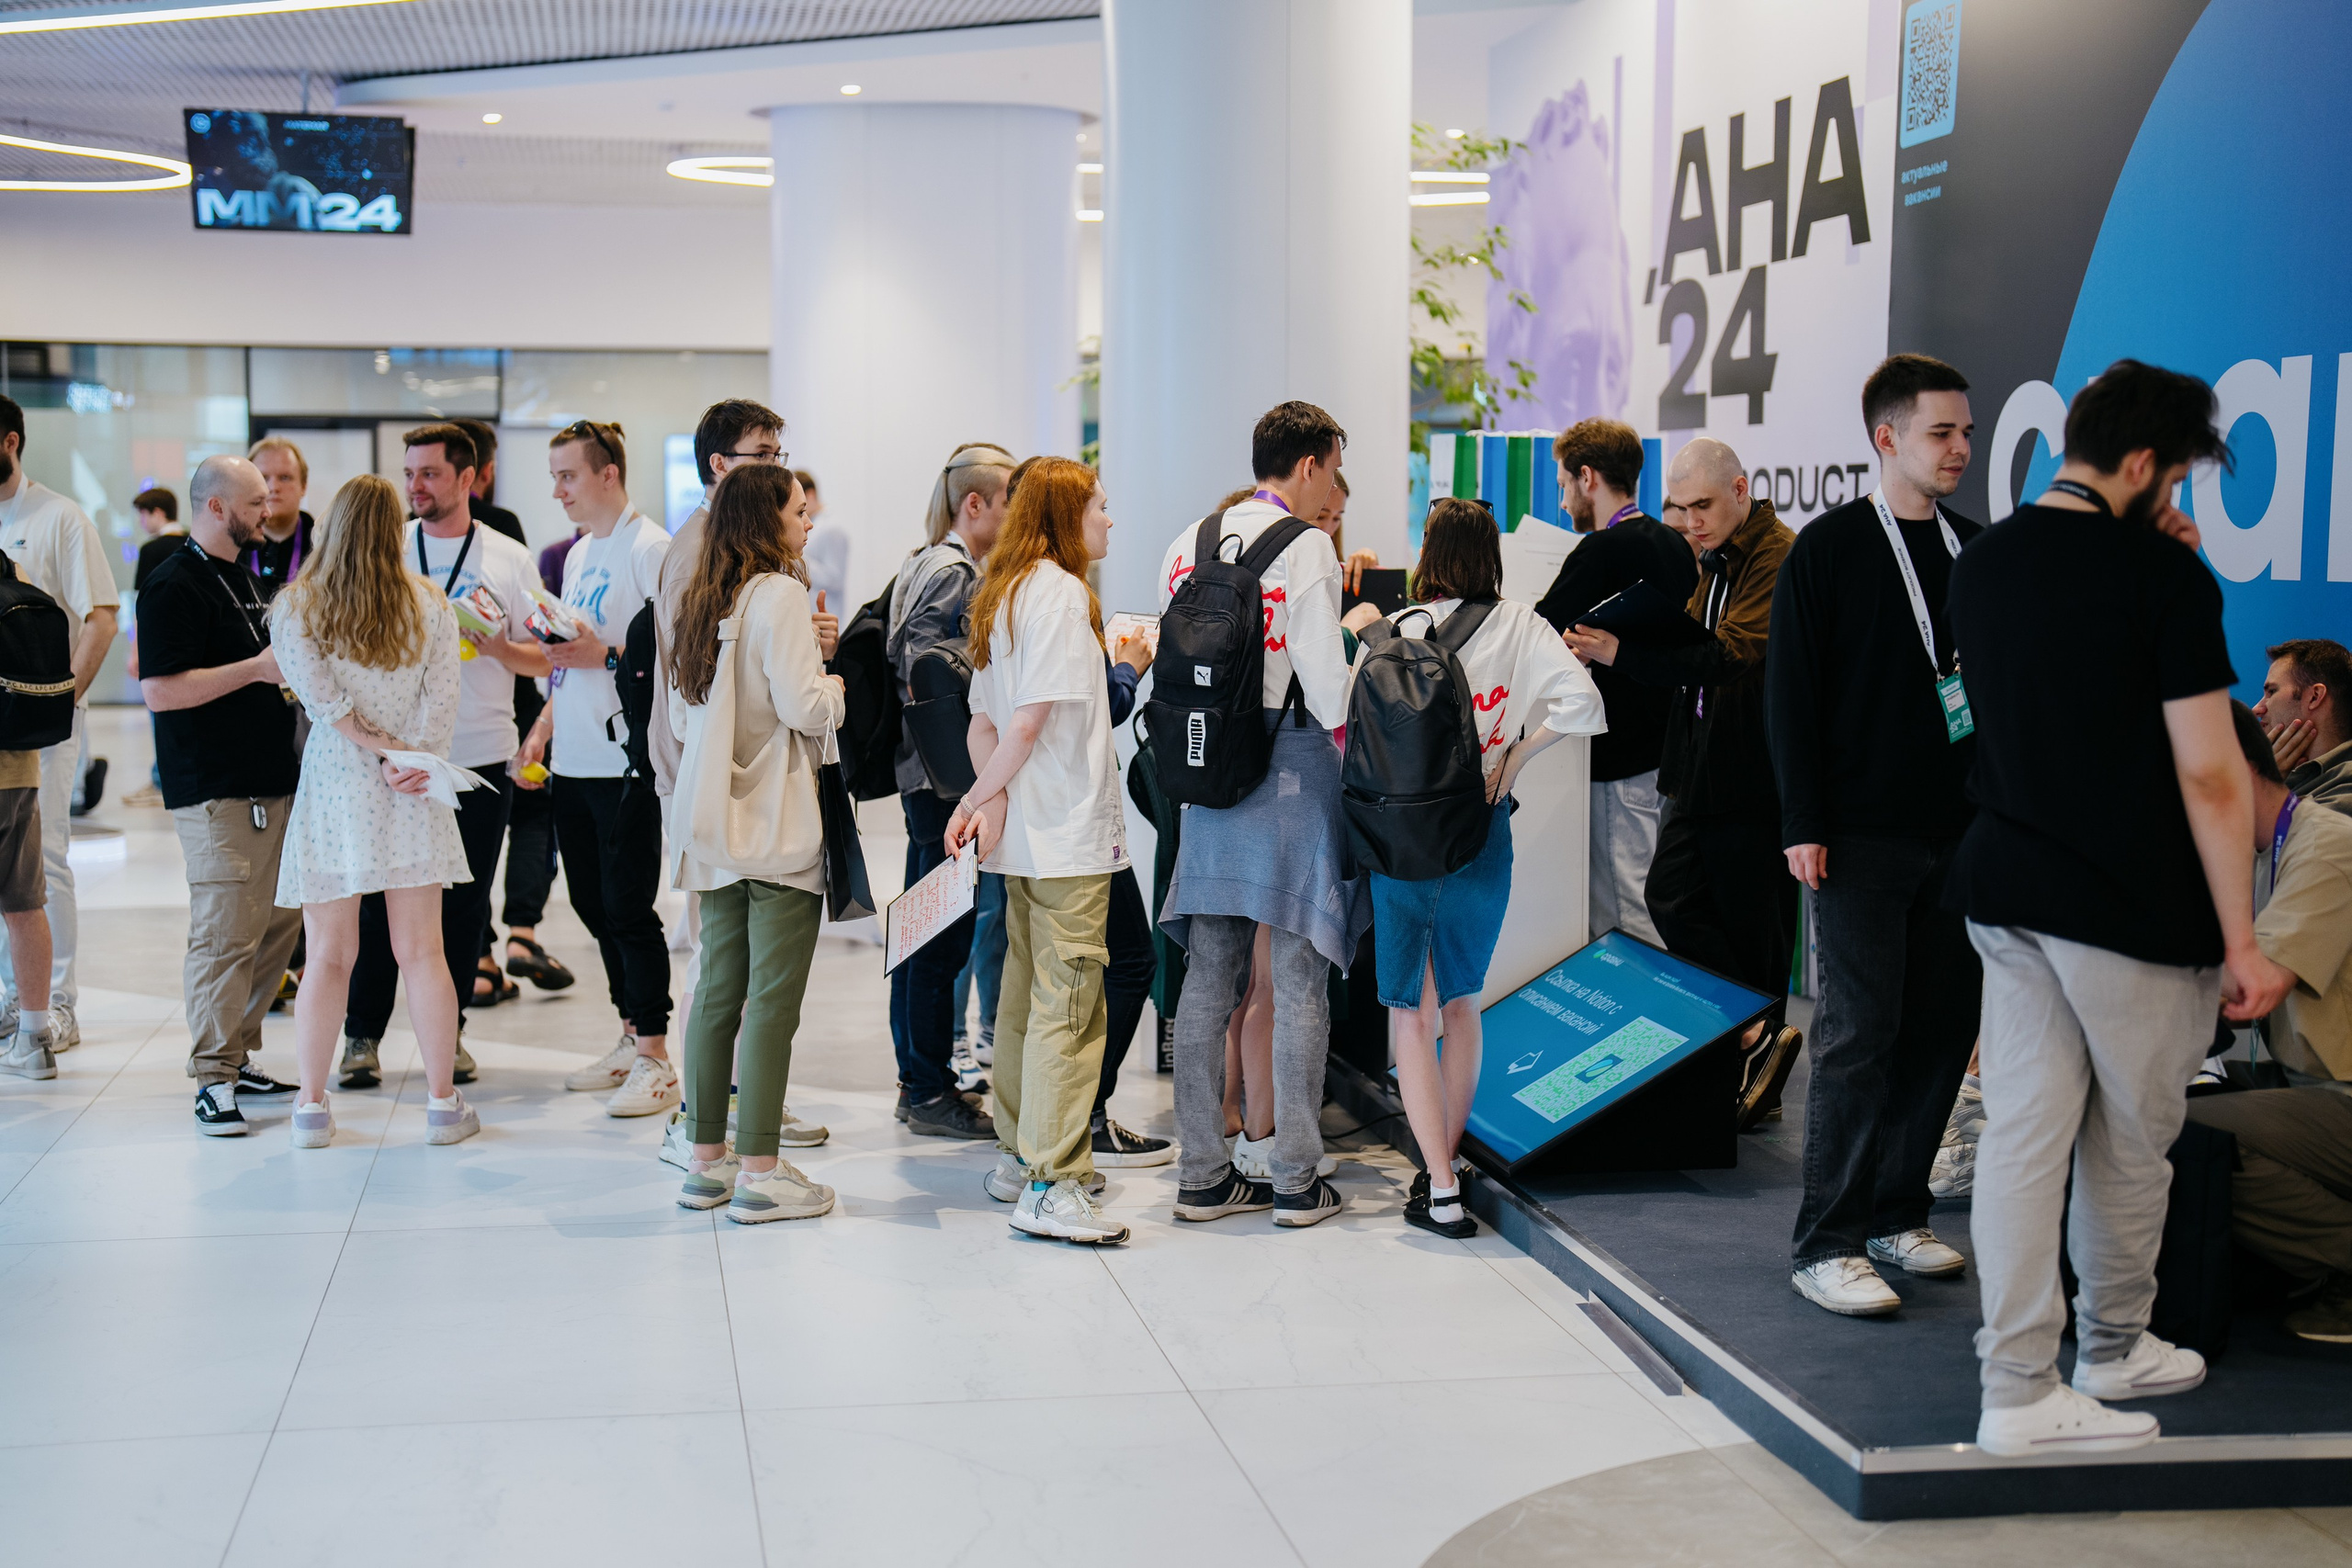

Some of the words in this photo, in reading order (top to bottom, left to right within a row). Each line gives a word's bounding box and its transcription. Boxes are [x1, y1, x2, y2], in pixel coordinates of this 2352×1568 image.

[1661, 74, 1871, 287] AHA
[1901, 160, 1949, 185] актуальные
[1905, 185, 1941, 207] вакансии
[1191, 718, 1204, 761] PUMA
[1518, 987, 1566, 1017] описанием
[1556, 1010, 1606, 1036] вакансий
[1545, 969, 1581, 994] Ссылка
[1572, 986, 1591, 999] на
[1583, 989, 1617, 1012] Notion
